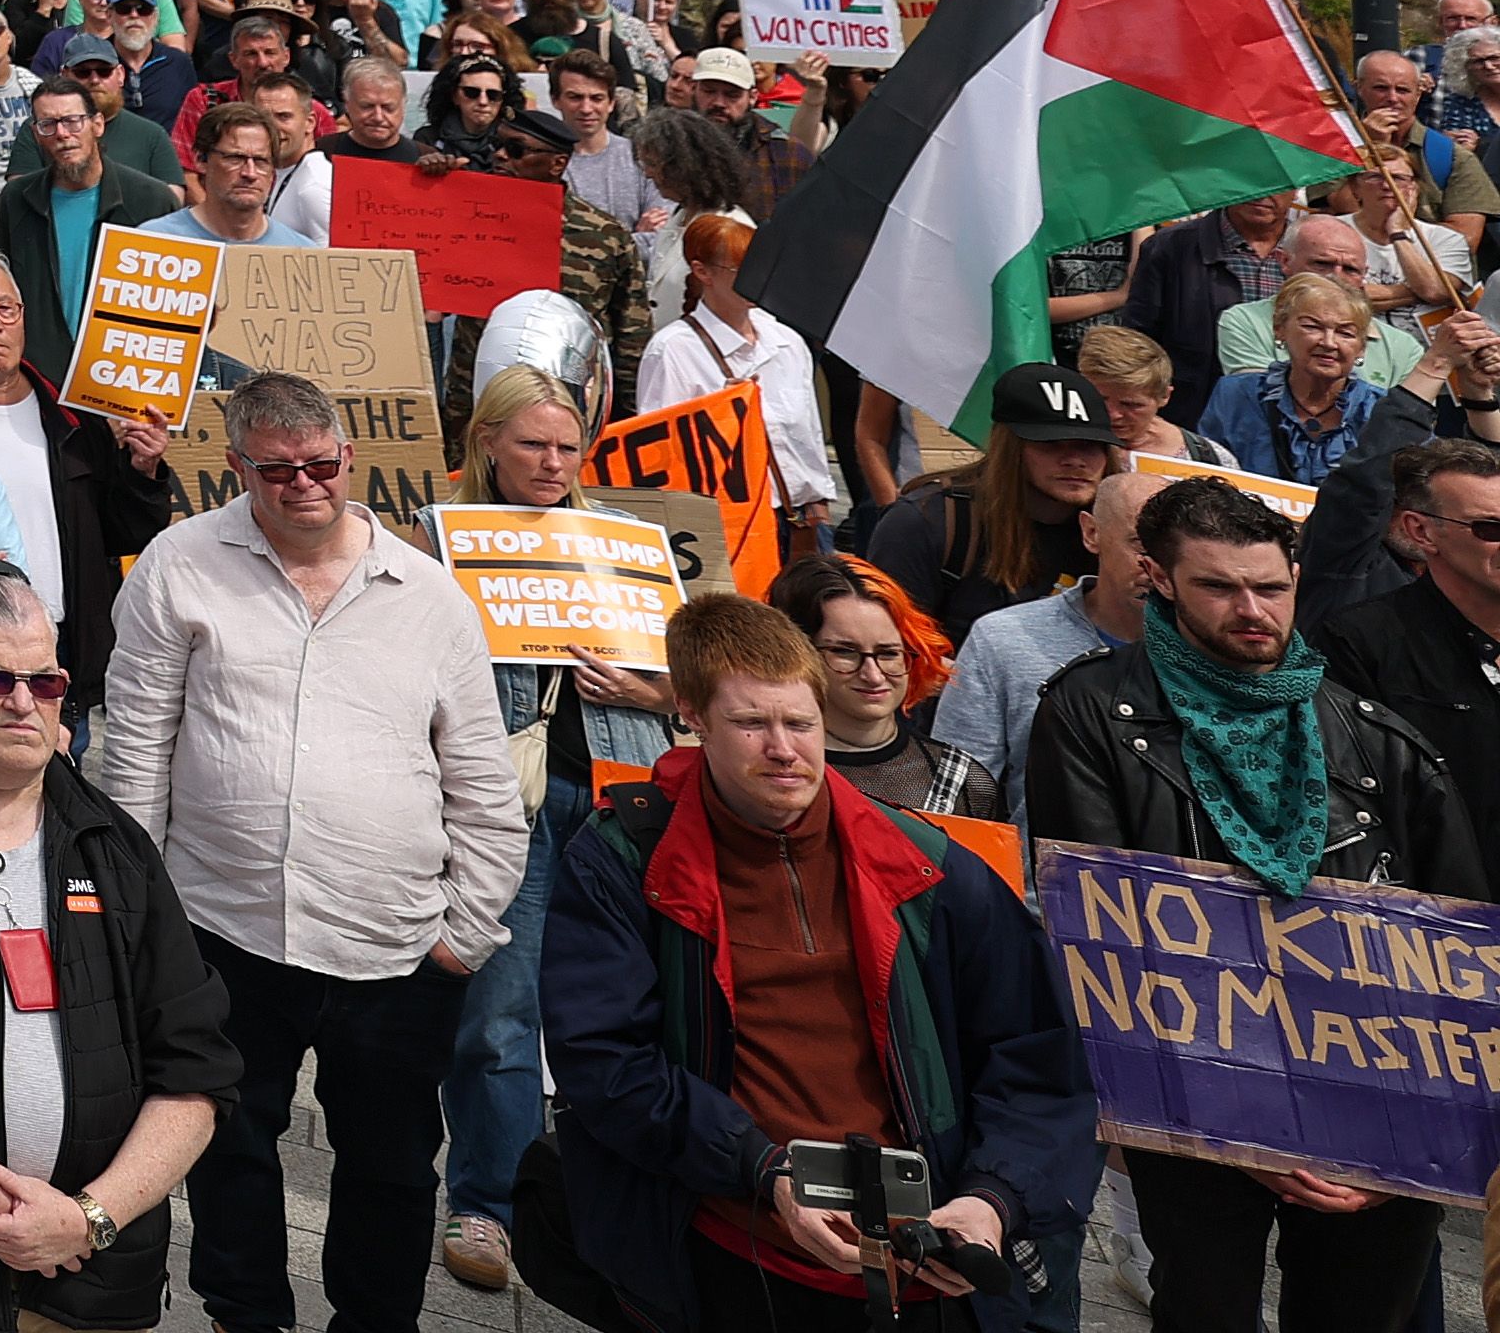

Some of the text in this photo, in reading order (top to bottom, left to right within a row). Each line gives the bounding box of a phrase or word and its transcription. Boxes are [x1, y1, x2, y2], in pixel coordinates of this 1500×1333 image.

[116, 249, 203, 283] STOP
[98, 277, 208, 318] TRUMP
[102, 328, 186, 364] FREE
[241, 317, 376, 380] WAS
[89, 360, 181, 397] GAZA
[1040, 382, 1090, 422] VA
[449, 529, 544, 561] STOP
[550, 532, 666, 569] TRUMP
[479, 575, 663, 613] MIGRANTS
[485, 602, 668, 636] WELCOME
[1063, 944, 1197, 1045] NO
